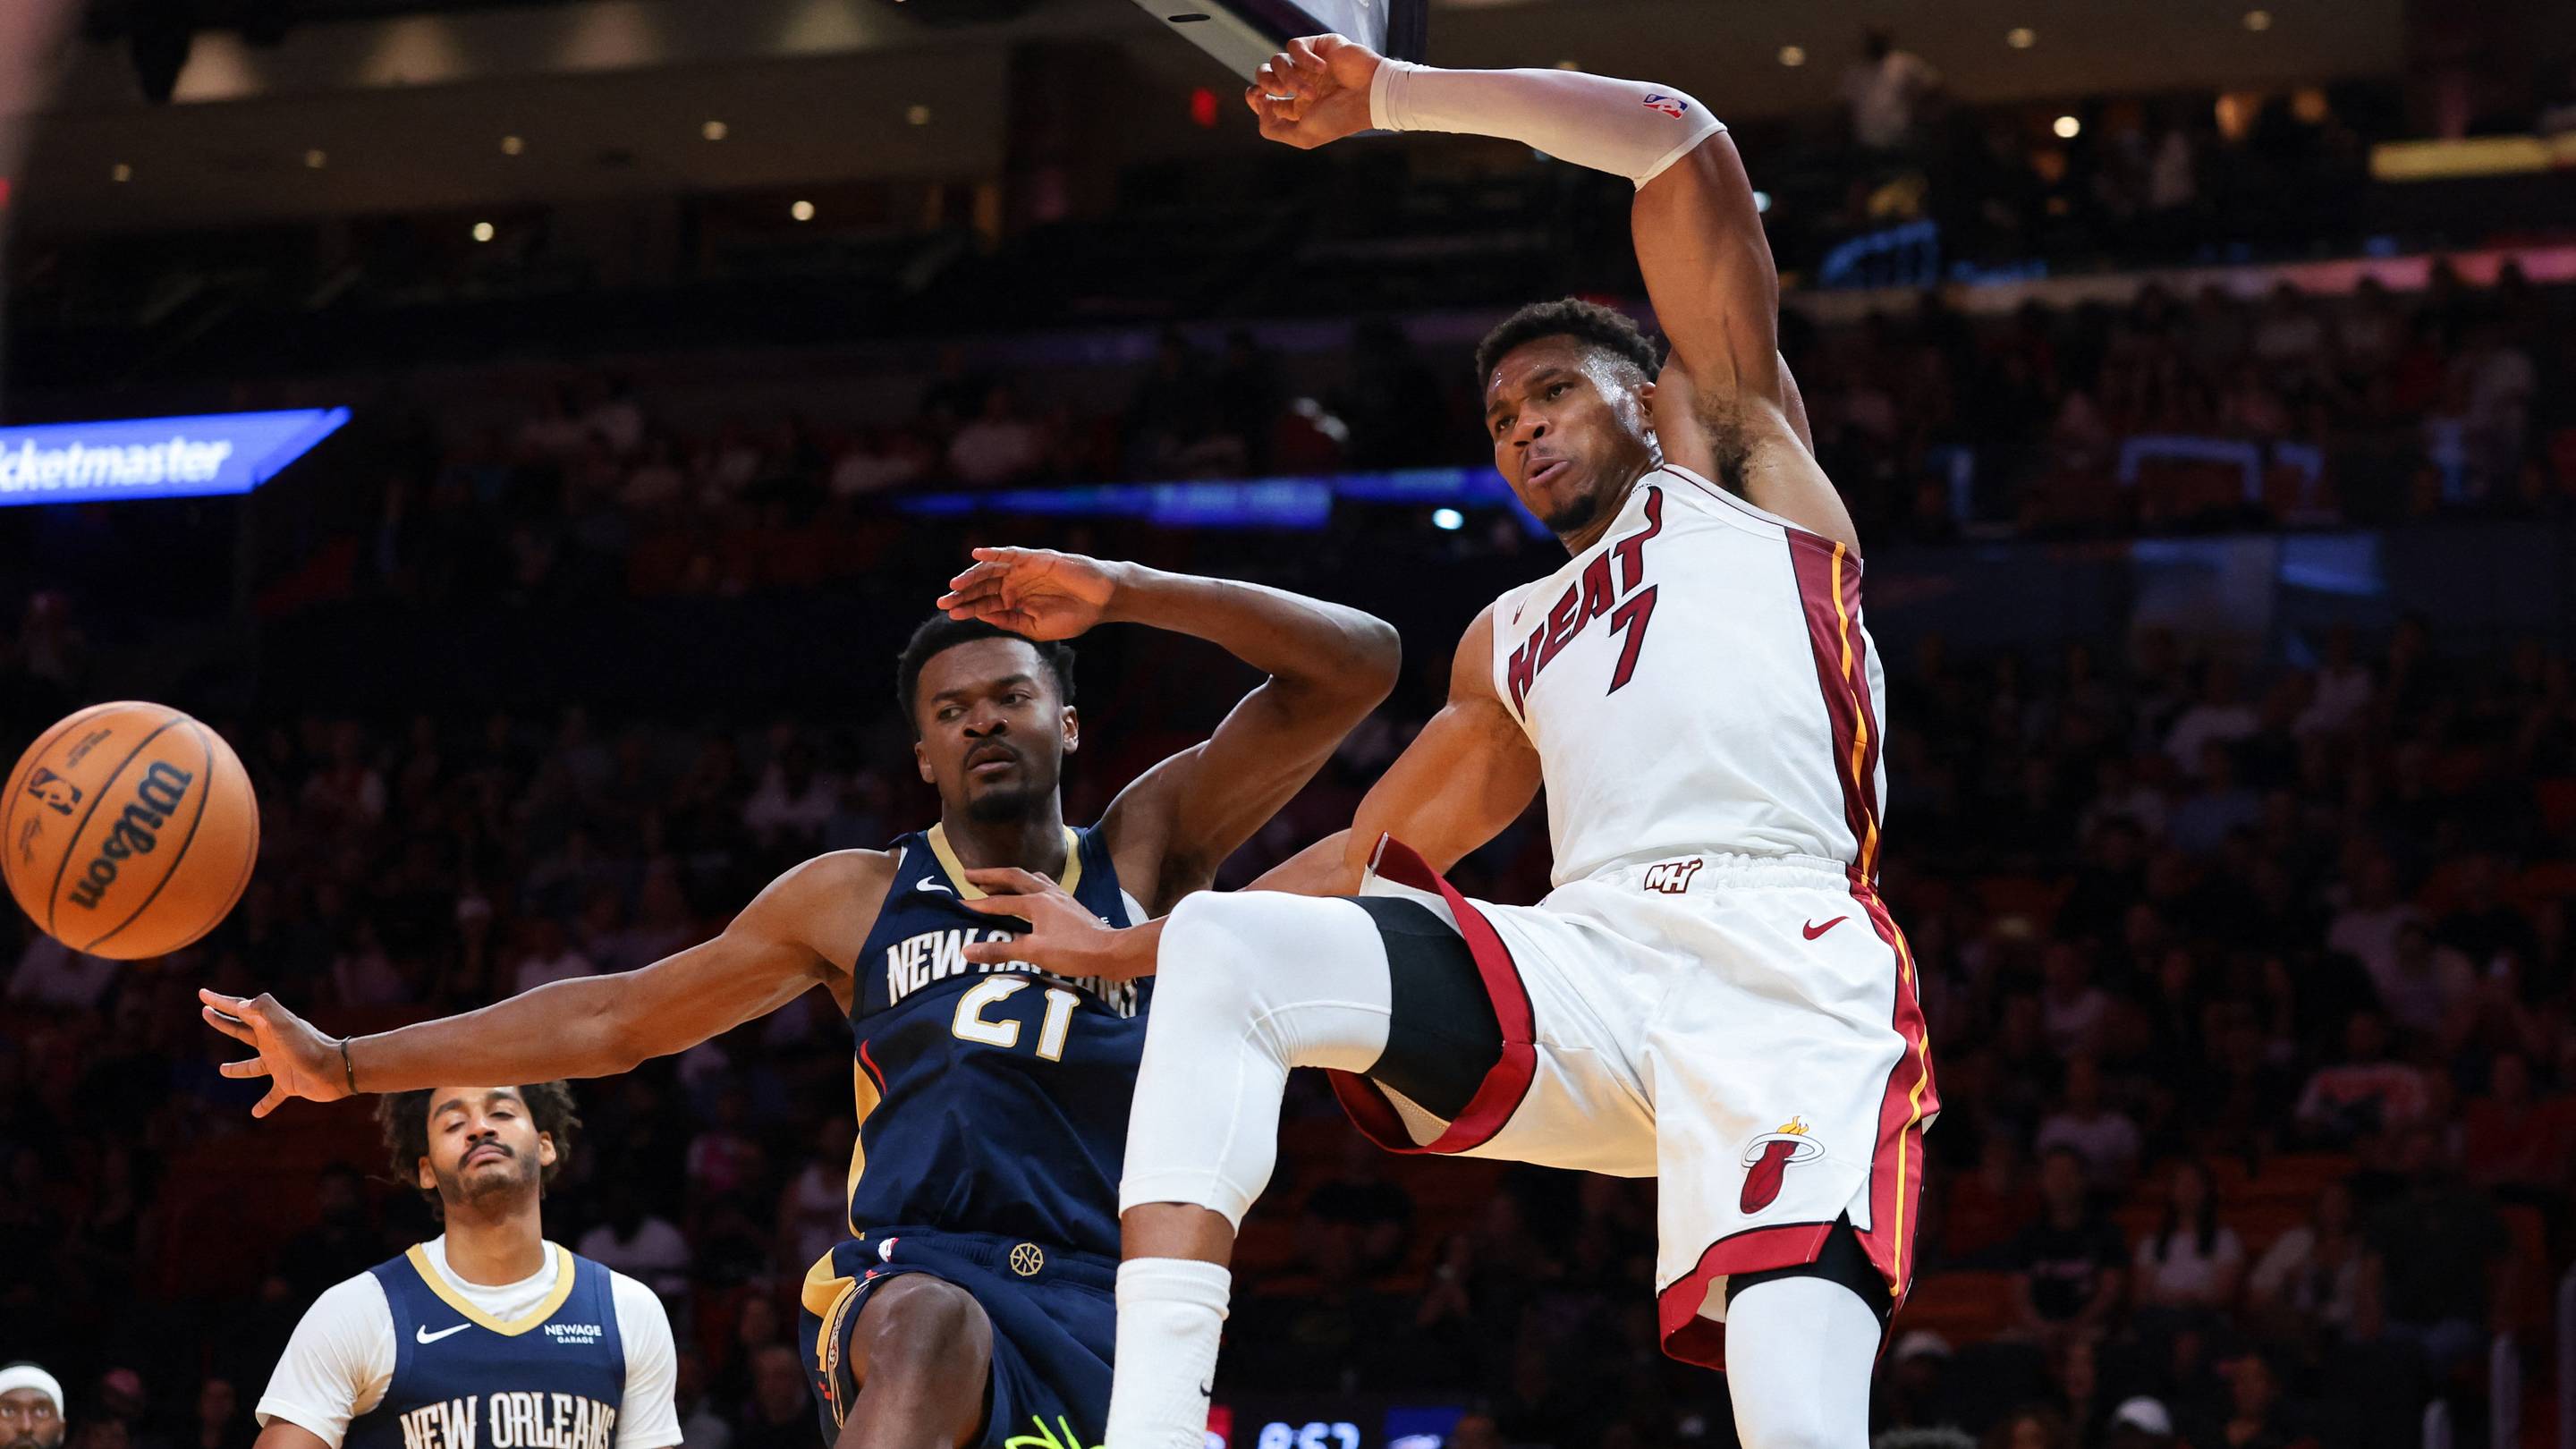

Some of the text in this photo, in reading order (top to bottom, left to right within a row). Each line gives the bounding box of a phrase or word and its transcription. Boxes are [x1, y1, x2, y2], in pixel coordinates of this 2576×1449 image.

[1507, 485, 1663, 723] HEAT
[1606, 583, 1658, 697] 7
[69, 761, 193, 911] Wilson
[886, 928, 979, 1007] NEW
[952, 974, 1080, 1063] 21
[544, 1324, 602, 1336] NEWAGE
[556, 1335, 595, 1344] GARAGE
[400, 1391, 616, 1449] NEW ORLEANS
